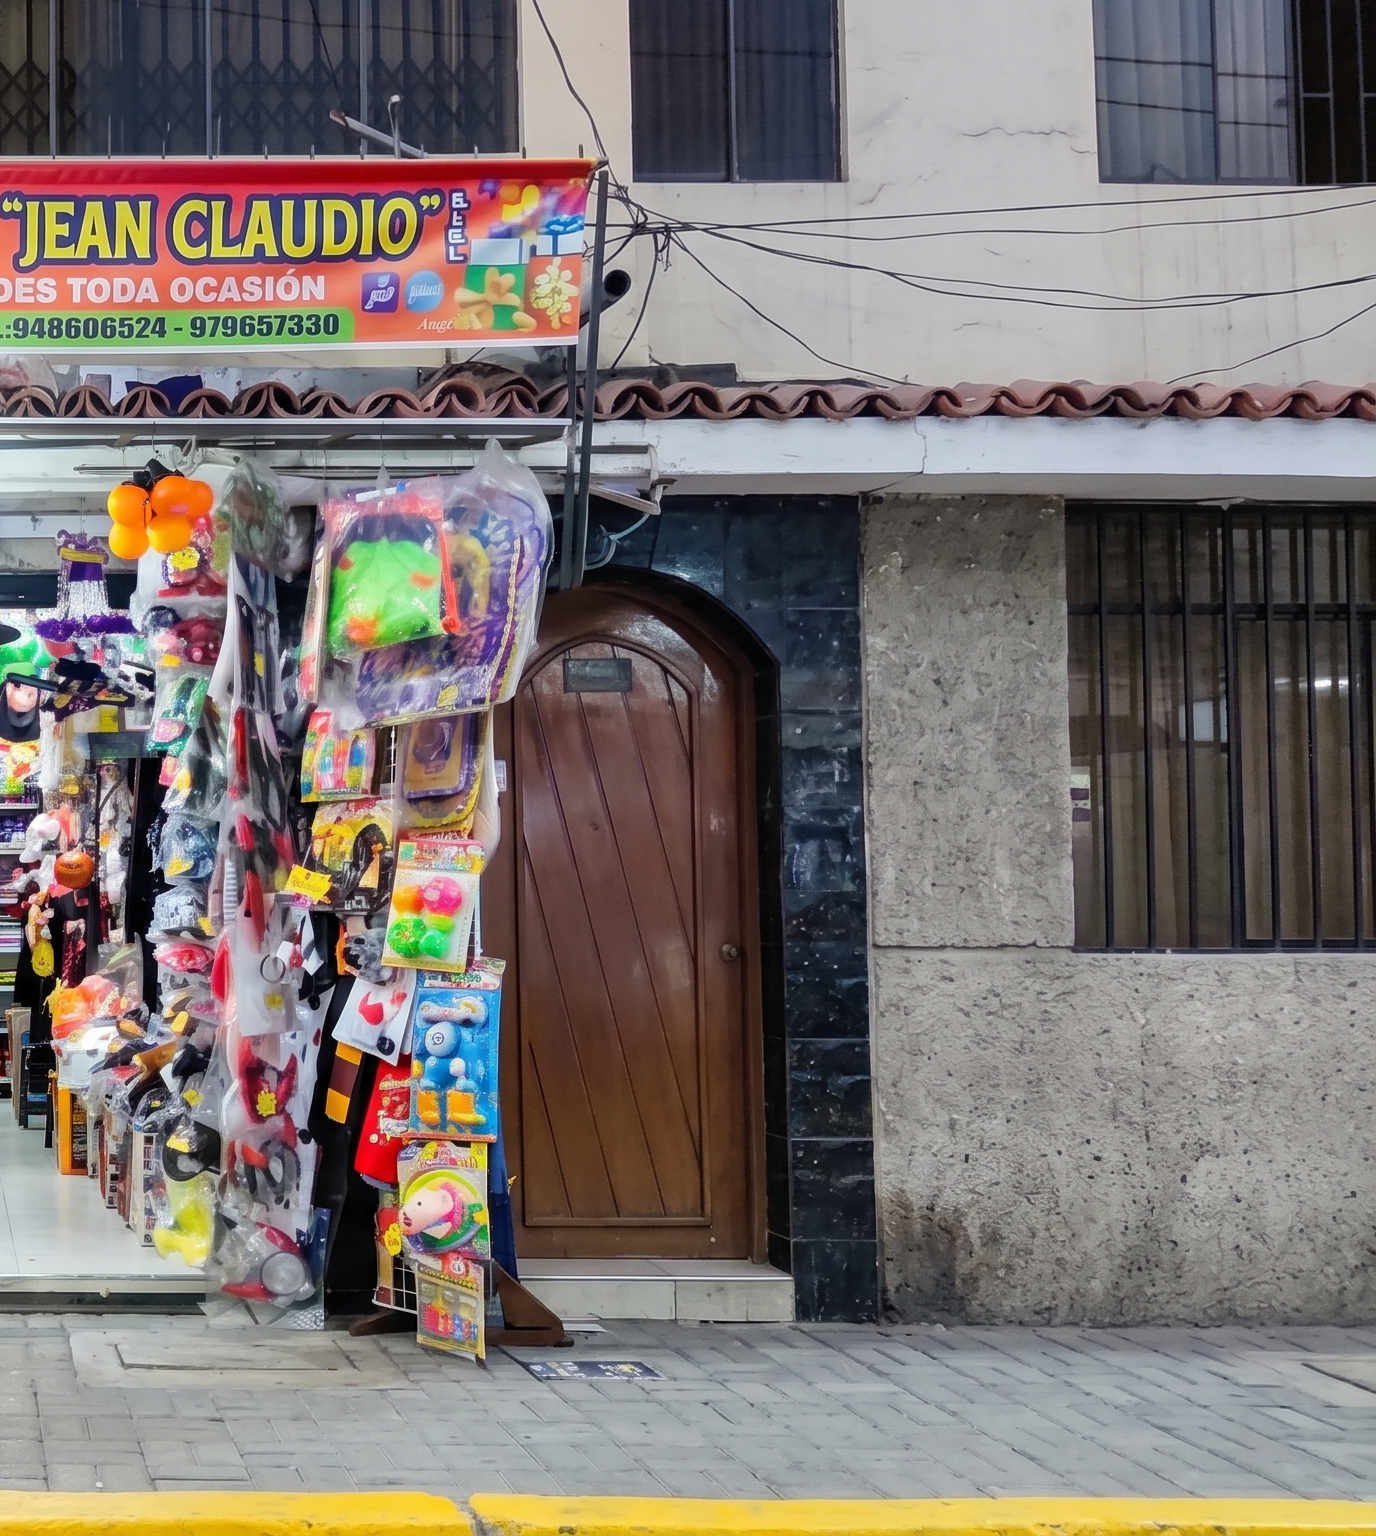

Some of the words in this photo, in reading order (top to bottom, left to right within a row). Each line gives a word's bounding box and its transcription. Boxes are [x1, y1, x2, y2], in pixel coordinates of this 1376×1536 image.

[66, 276, 159, 304] TODA
[169, 266, 326, 303] OCASIÓN
[190, 313, 340, 339] 979657330
